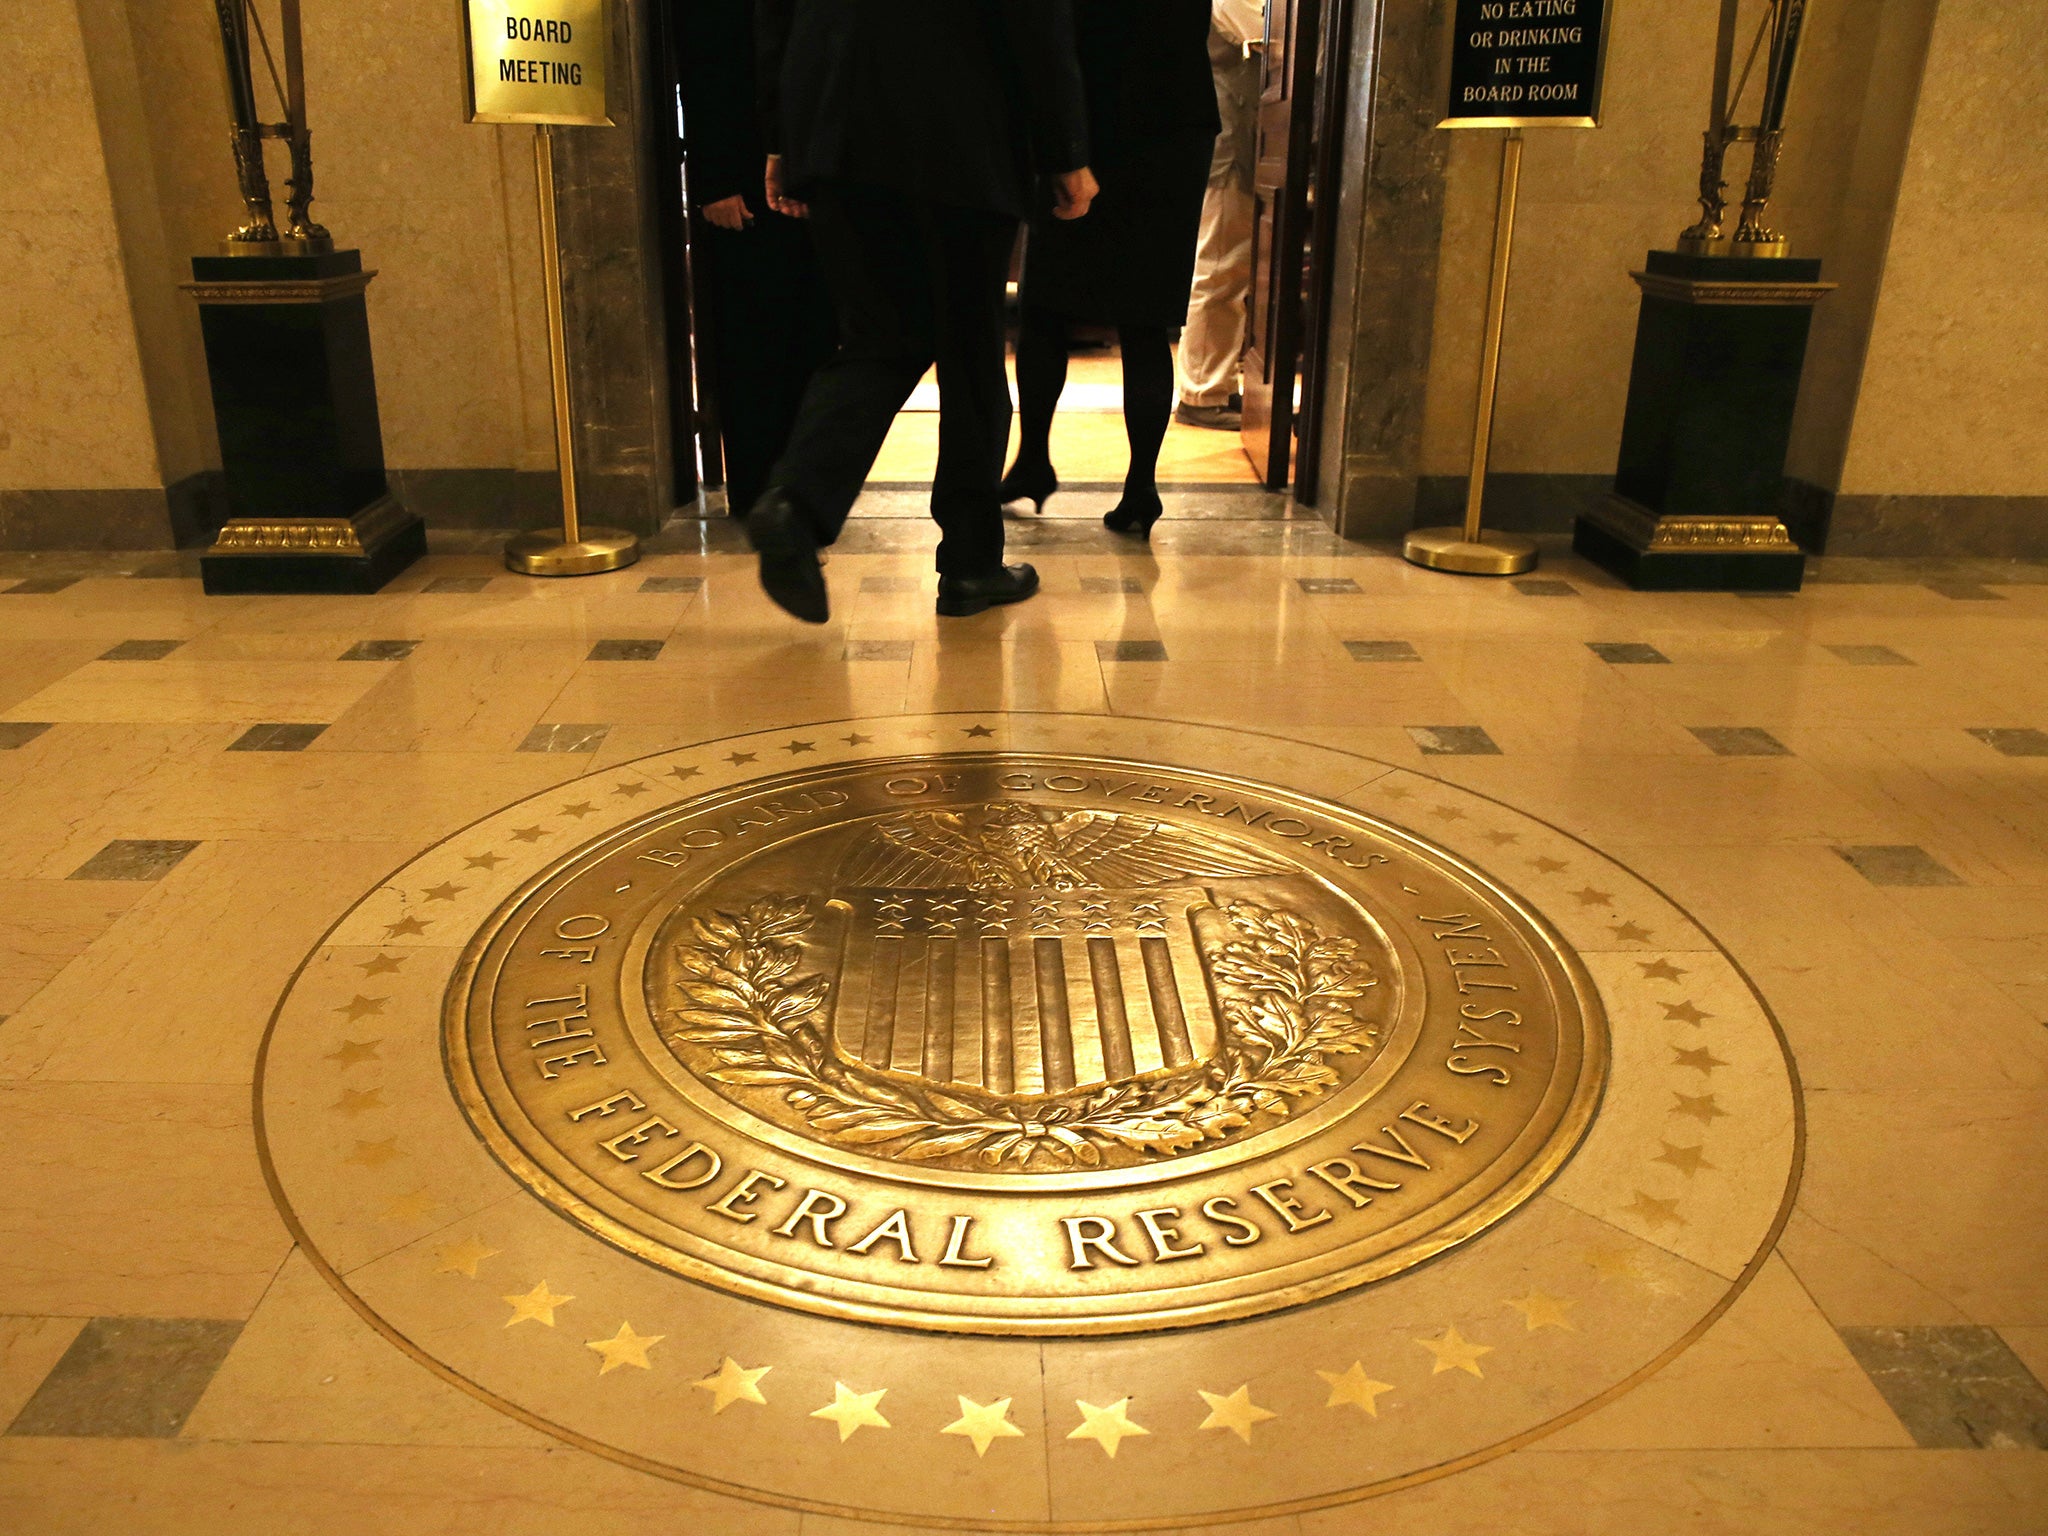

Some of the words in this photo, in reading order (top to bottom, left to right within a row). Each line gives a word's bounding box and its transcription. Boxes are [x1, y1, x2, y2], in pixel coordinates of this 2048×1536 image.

[1481, 4, 1503, 20] NO
[1509, 0, 1576, 18] EATING
[506, 16, 572, 44] BOARD
[1470, 31, 1492, 48] OR
[1499, 27, 1582, 47] DRINKING
[499, 59, 582, 86] MEETING
[1495, 58, 1511, 74] IN
[1516, 56, 1551, 73] THE
[1463, 86, 1523, 102] BOARD
[1528, 84, 1578, 101] ROOM
[636, 790, 849, 868] BOARD
[885, 773, 962, 795] OF
[999, 772, 1390, 869] GOVERNORS
[539, 914, 610, 963] OF
[1416, 912, 1523, 1085] SYSTEM
[526, 983, 607, 1079] THE
[570, 1089, 995, 1268] FEDERAL
[1060, 1099, 1479, 1270] RESERVE
